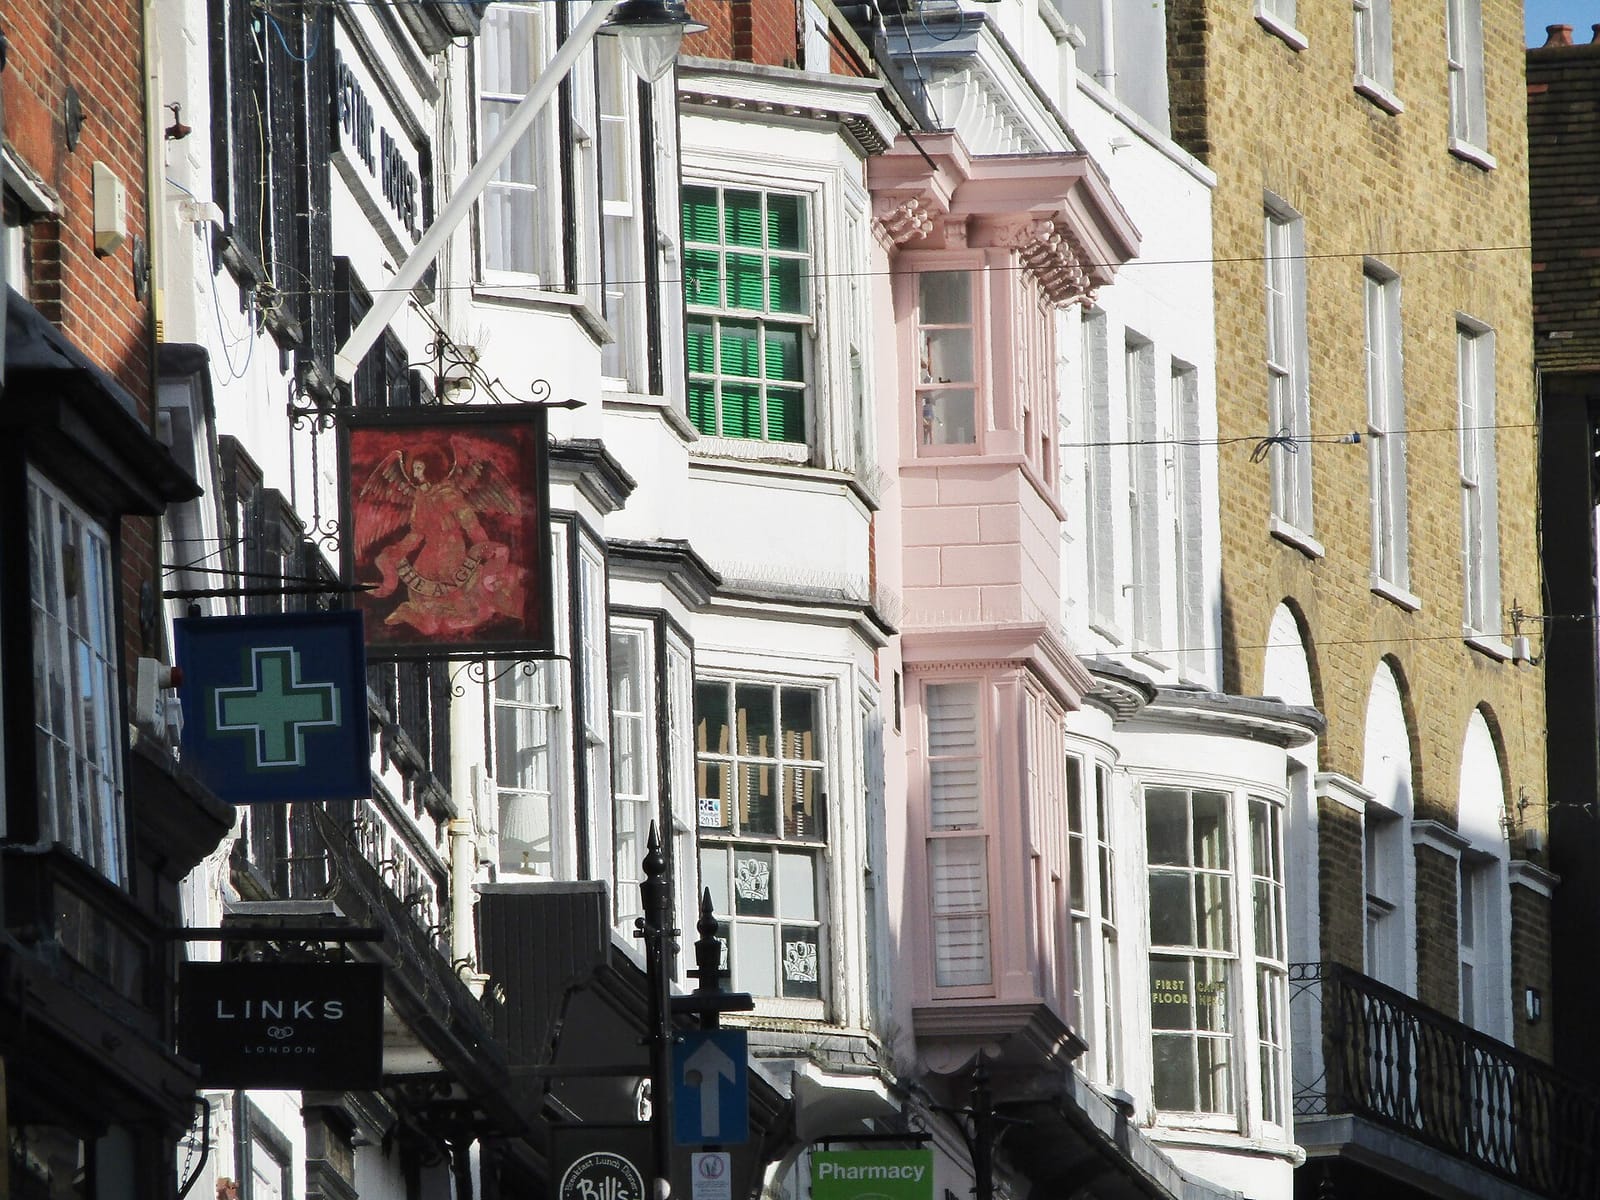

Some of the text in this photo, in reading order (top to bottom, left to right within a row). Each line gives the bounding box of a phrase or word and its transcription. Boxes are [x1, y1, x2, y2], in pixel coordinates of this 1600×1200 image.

[380, 126, 422, 245] HOUSE
[396, 554, 481, 597] THE ANGEL
[700, 816, 720, 826] 2015
[1155, 979, 1185, 991] FIRST
[1152, 992, 1189, 1004] FLOOR
[217, 1000, 344, 1020] LINKS
[244, 1046, 317, 1054] LONDON
[565, 1156, 638, 1192] Breakfast Lunch Dinner
[818, 1162, 925, 1182] Pharmacy
[576, 1175, 629, 1200] Bill's
